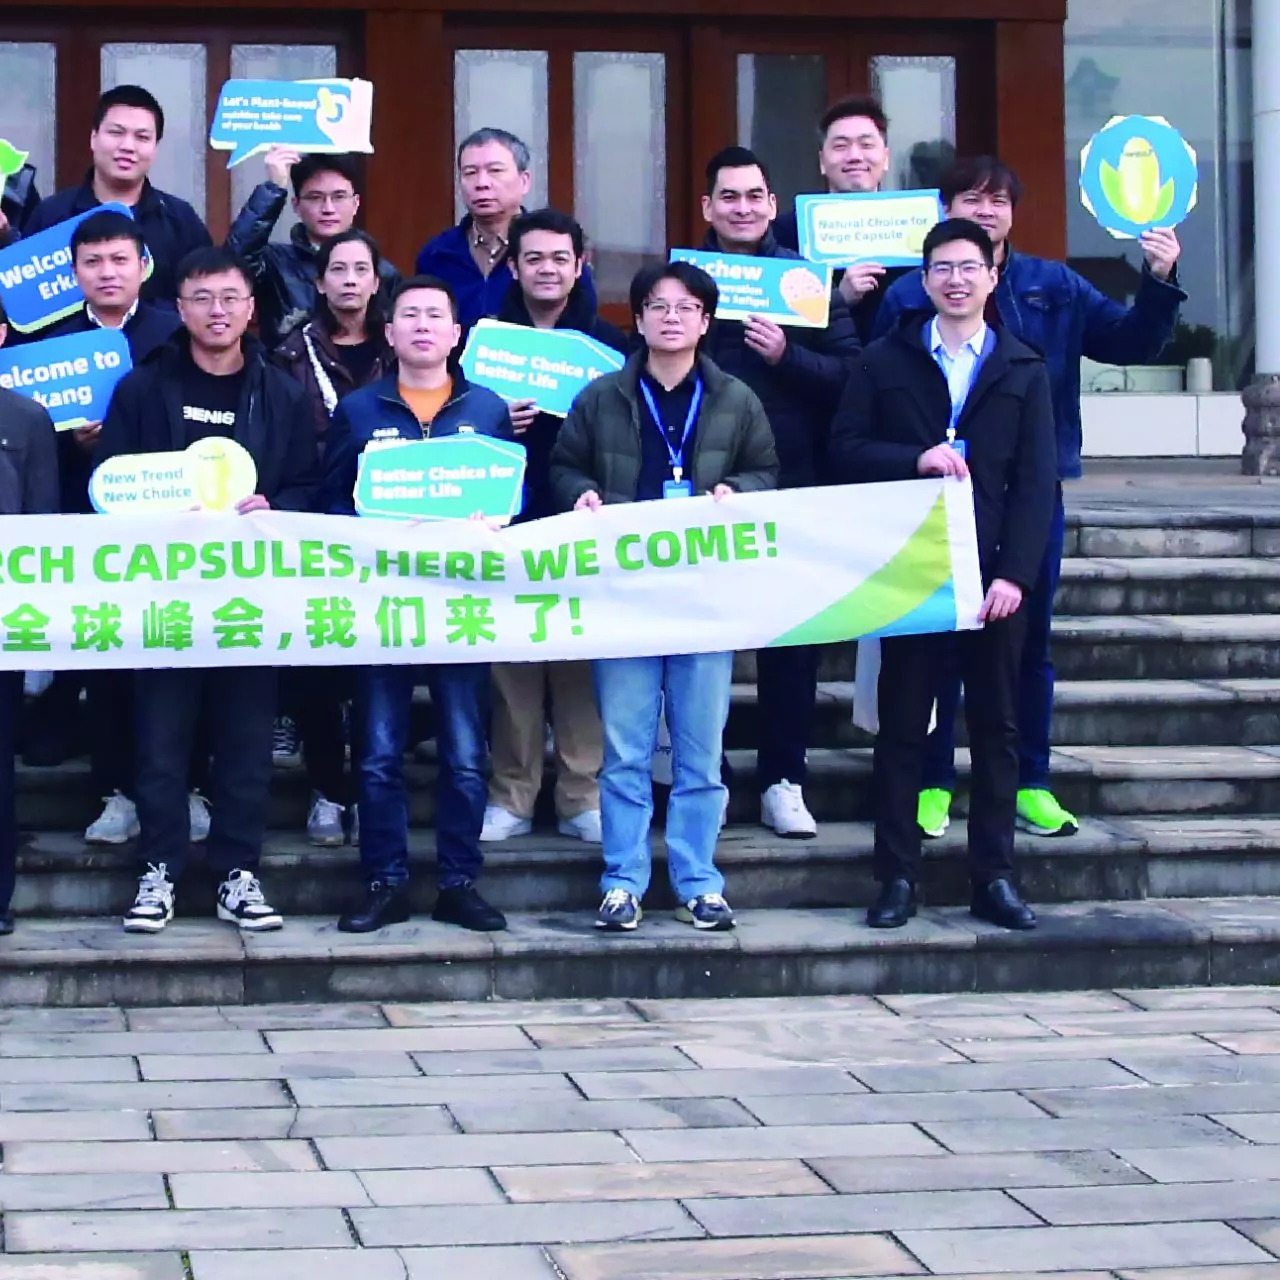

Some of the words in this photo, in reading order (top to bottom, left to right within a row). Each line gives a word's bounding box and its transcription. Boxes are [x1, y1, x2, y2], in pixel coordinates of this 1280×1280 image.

[818, 218, 864, 230] Natural
[867, 216, 908, 228] Choice
[911, 215, 928, 226] for
[819, 232, 851, 243] Vege
[854, 230, 903, 243] Capsule
[93, 350, 120, 370] to
[476, 345, 528, 366] Better
[531, 354, 584, 378] Choice
[474, 361, 526, 382] Better
[528, 371, 559, 390] Life
[32, 385, 93, 409] kang
[103, 472, 137, 485] New
[141, 467, 184, 482] Trend
[371, 467, 425, 483] Better
[428, 465, 487, 481] Choice
[489, 464, 516, 479] for
[103, 490, 137, 503] New
[142, 485, 192, 500] Choice
[371, 484, 426, 500] Better
[428, 482, 463, 498] Life
[520, 537, 600, 583] WE
[614, 521, 779, 572] COME!
